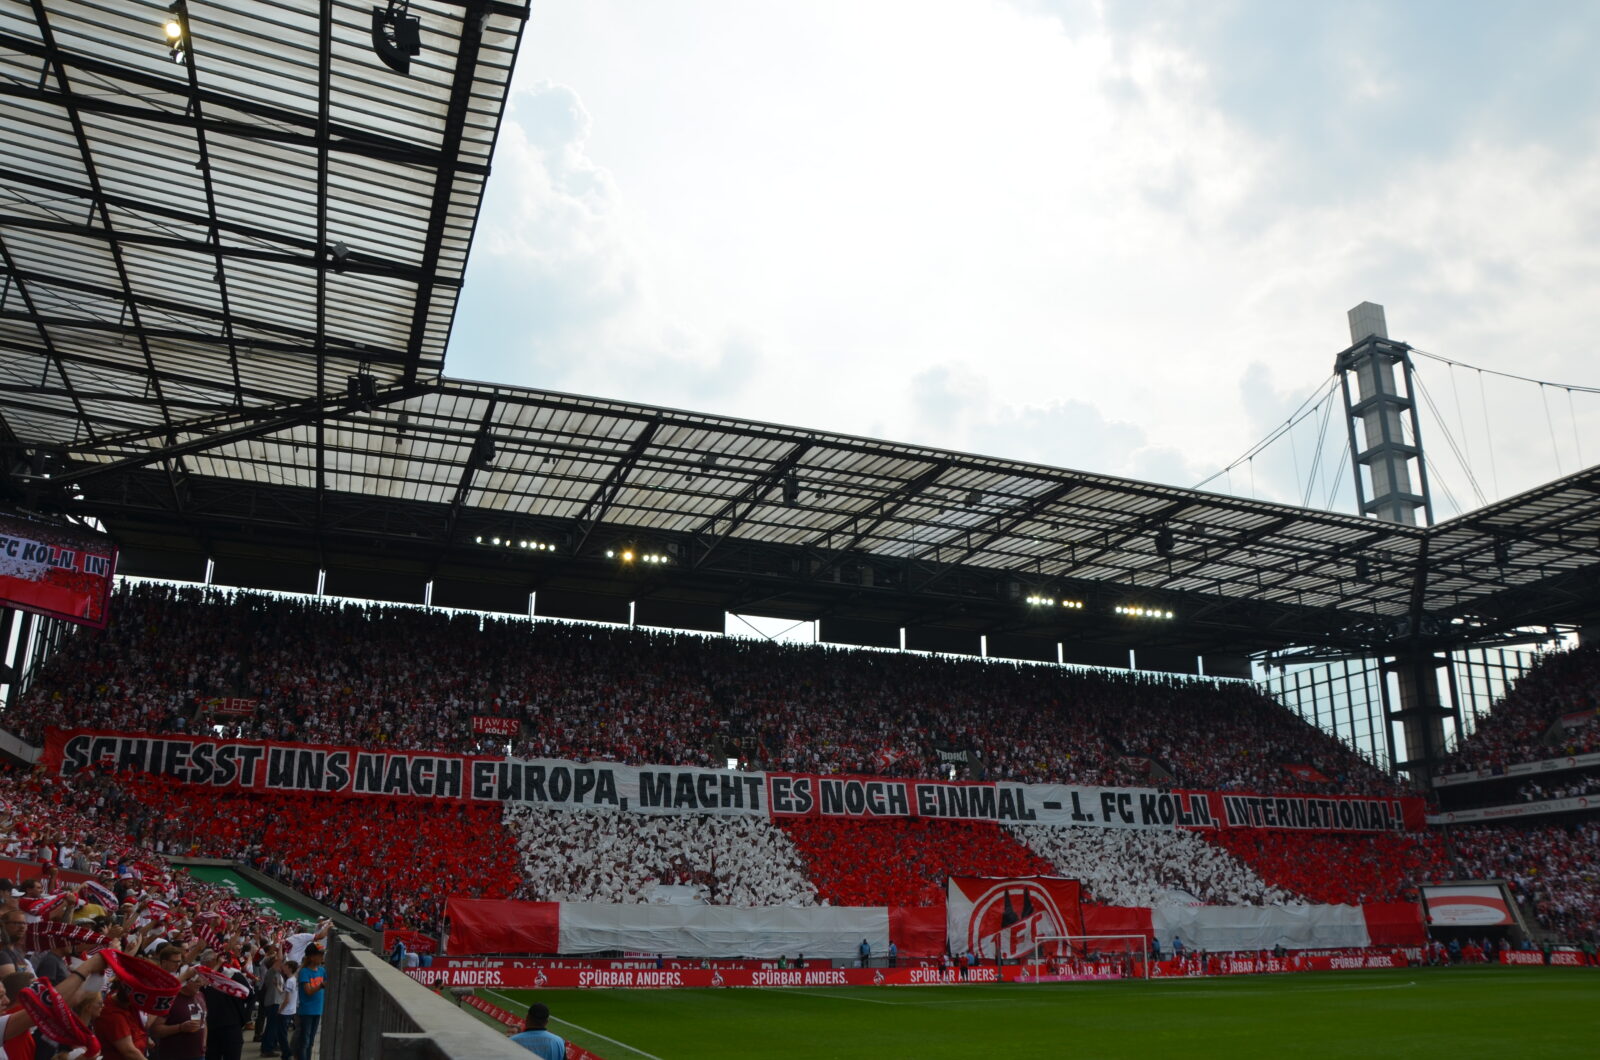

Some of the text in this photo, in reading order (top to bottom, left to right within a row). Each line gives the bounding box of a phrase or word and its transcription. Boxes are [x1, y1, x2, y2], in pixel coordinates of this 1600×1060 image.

[22, 541, 79, 573] KÖLN,
[473, 717, 519, 733] HAWKS
[484, 727, 508, 736] KÖLN
[62, 735, 265, 788] SCHIESST
[266, 747, 351, 791] UNS
[353, 752, 463, 799] NACH
[472, 760, 629, 811] EUROPA,
[639, 771, 763, 810] MACHT
[771, 777, 814, 814] ES
[819, 779, 909, 816] NOCH
[915, 784, 1037, 821] EINMAL
[1070, 791, 1094, 822] 1.
[1100, 792, 1135, 824] FC
[1139, 788, 1221, 831] KÖLN,
[1222, 796, 1405, 831] INTERNATIONAL!
[1365, 956, 1394, 968] NDERS.
[452, 970, 505, 985] ANDERS.
[579, 968, 685, 986] SPÜRBAR ANDERS.
[752, 968, 849, 985] SPÜRBAR ANDERS.
